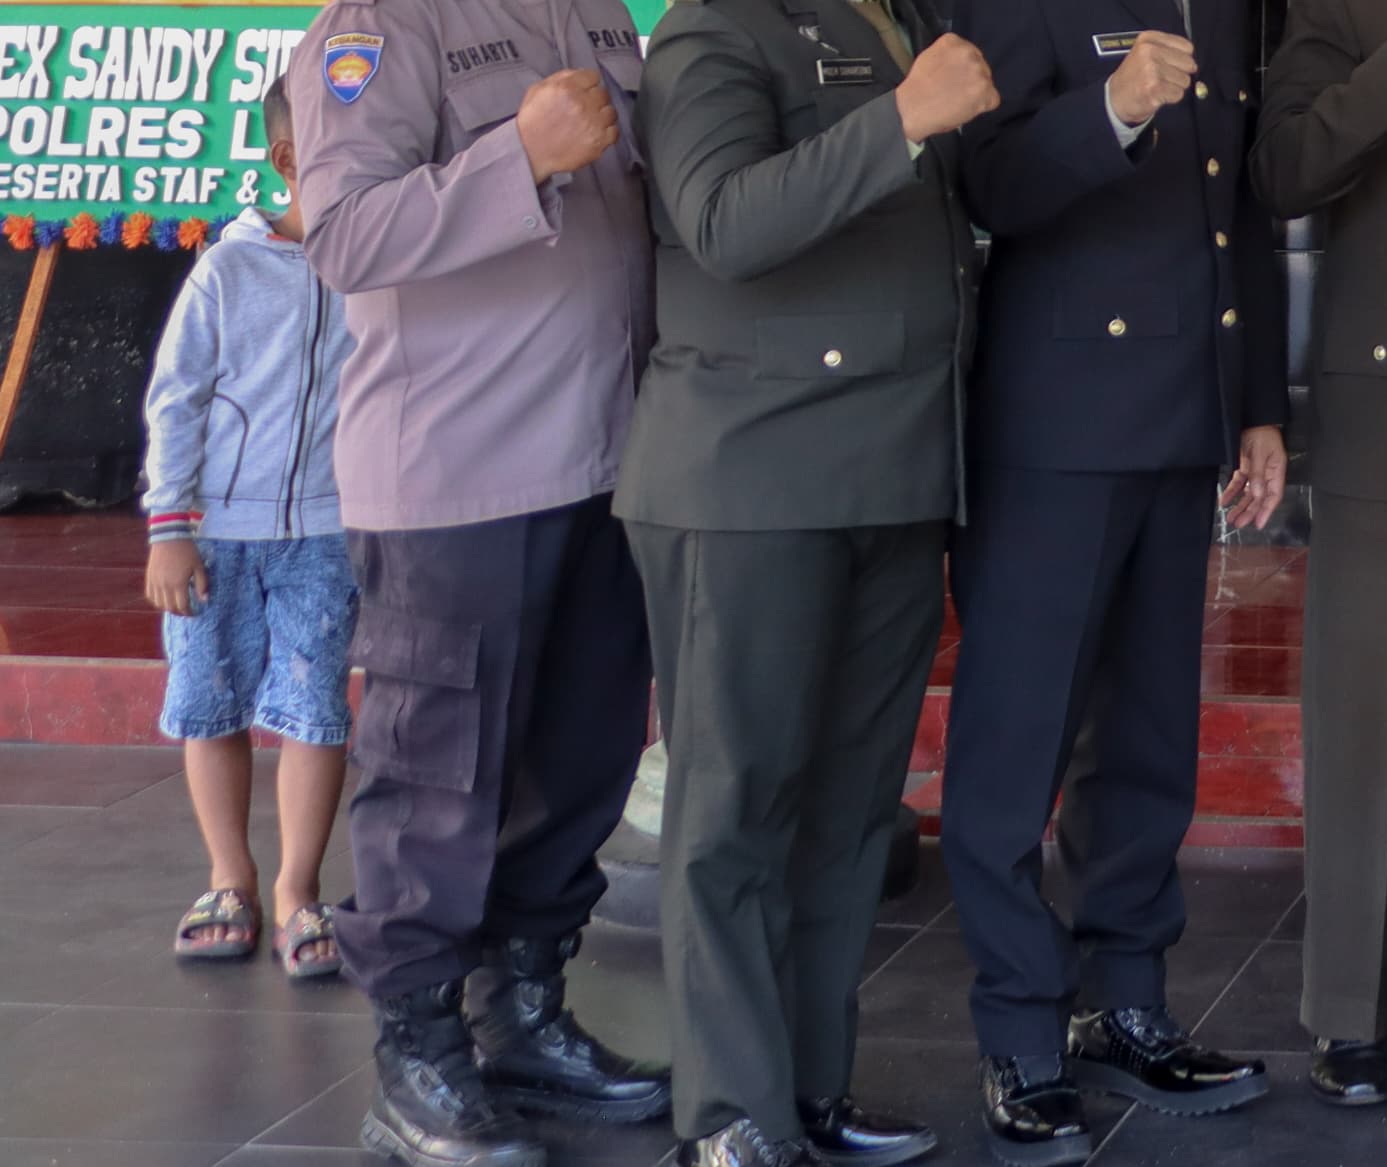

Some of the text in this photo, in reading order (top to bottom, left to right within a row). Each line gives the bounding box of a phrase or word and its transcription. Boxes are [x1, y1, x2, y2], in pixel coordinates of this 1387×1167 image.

[0, 24, 59, 99] EX
[63, 25, 225, 101] SANDY
[0, 104, 205, 160] OLRES
[0, 162, 122, 202] ESERTA
[132, 166, 225, 204] STAF
[235, 169, 260, 205] &
